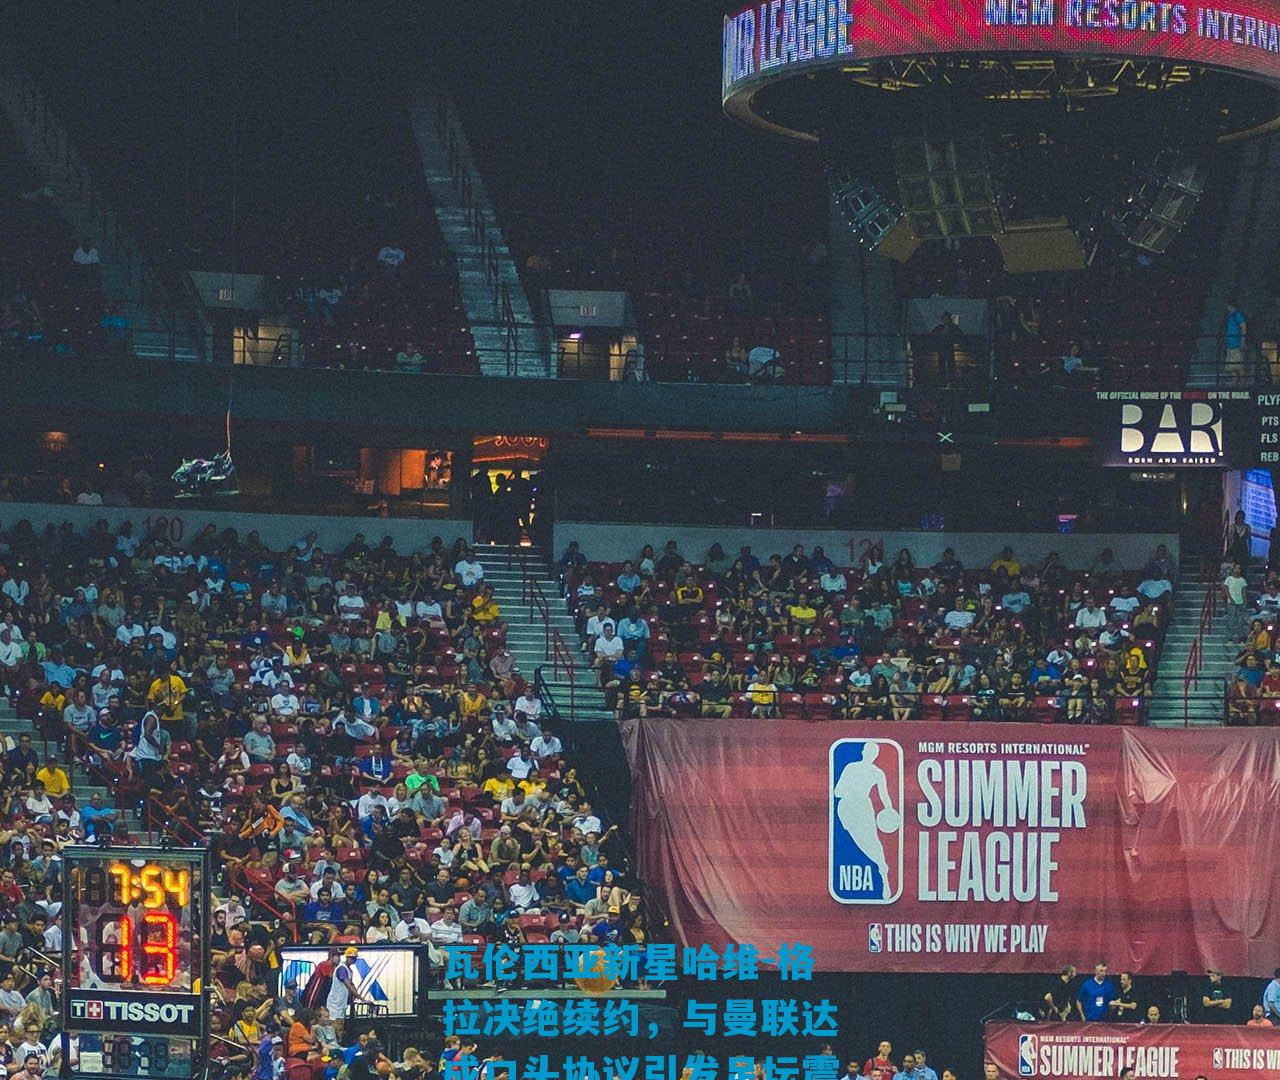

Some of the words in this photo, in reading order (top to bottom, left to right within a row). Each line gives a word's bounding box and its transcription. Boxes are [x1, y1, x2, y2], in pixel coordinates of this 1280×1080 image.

[985, 0, 1054, 25] MGM
[1065, 0, 1187, 34] RESORTS
[759, 0, 853, 70] LEAGUE
[1261, 416, 1279, 426] PTS
[1261, 434, 1278, 444] FLS
[1261, 452, 1279, 462] REB
[918, 742, 943, 752] MGM
[948, 743, 997, 754] RESORTS
[1001, 743, 1086, 755] INTERNATIONAL
[917, 759, 1087, 828] SUMMER
[839, 865, 873, 891] NBA
[918, 832, 1059, 901] LEAGUE
[109, 863, 189, 909] 7:54
[120, 913, 178, 985] 13
[885, 924, 922, 952] THIS
[926, 924, 942, 952] IS
[944, 924, 980, 952] WHY
[984, 925, 1007, 952] WE
[1010, 925, 1048, 953] PLAY
[105, 1002, 194, 1024] TISSOT
[1040, 1046, 1113, 1077] SUMMER
[1118, 1046, 1179, 1078] LEAGUE
[1225, 1049, 1250, 1070] THIS
[1253, 1049, 1264, 1070] IS
